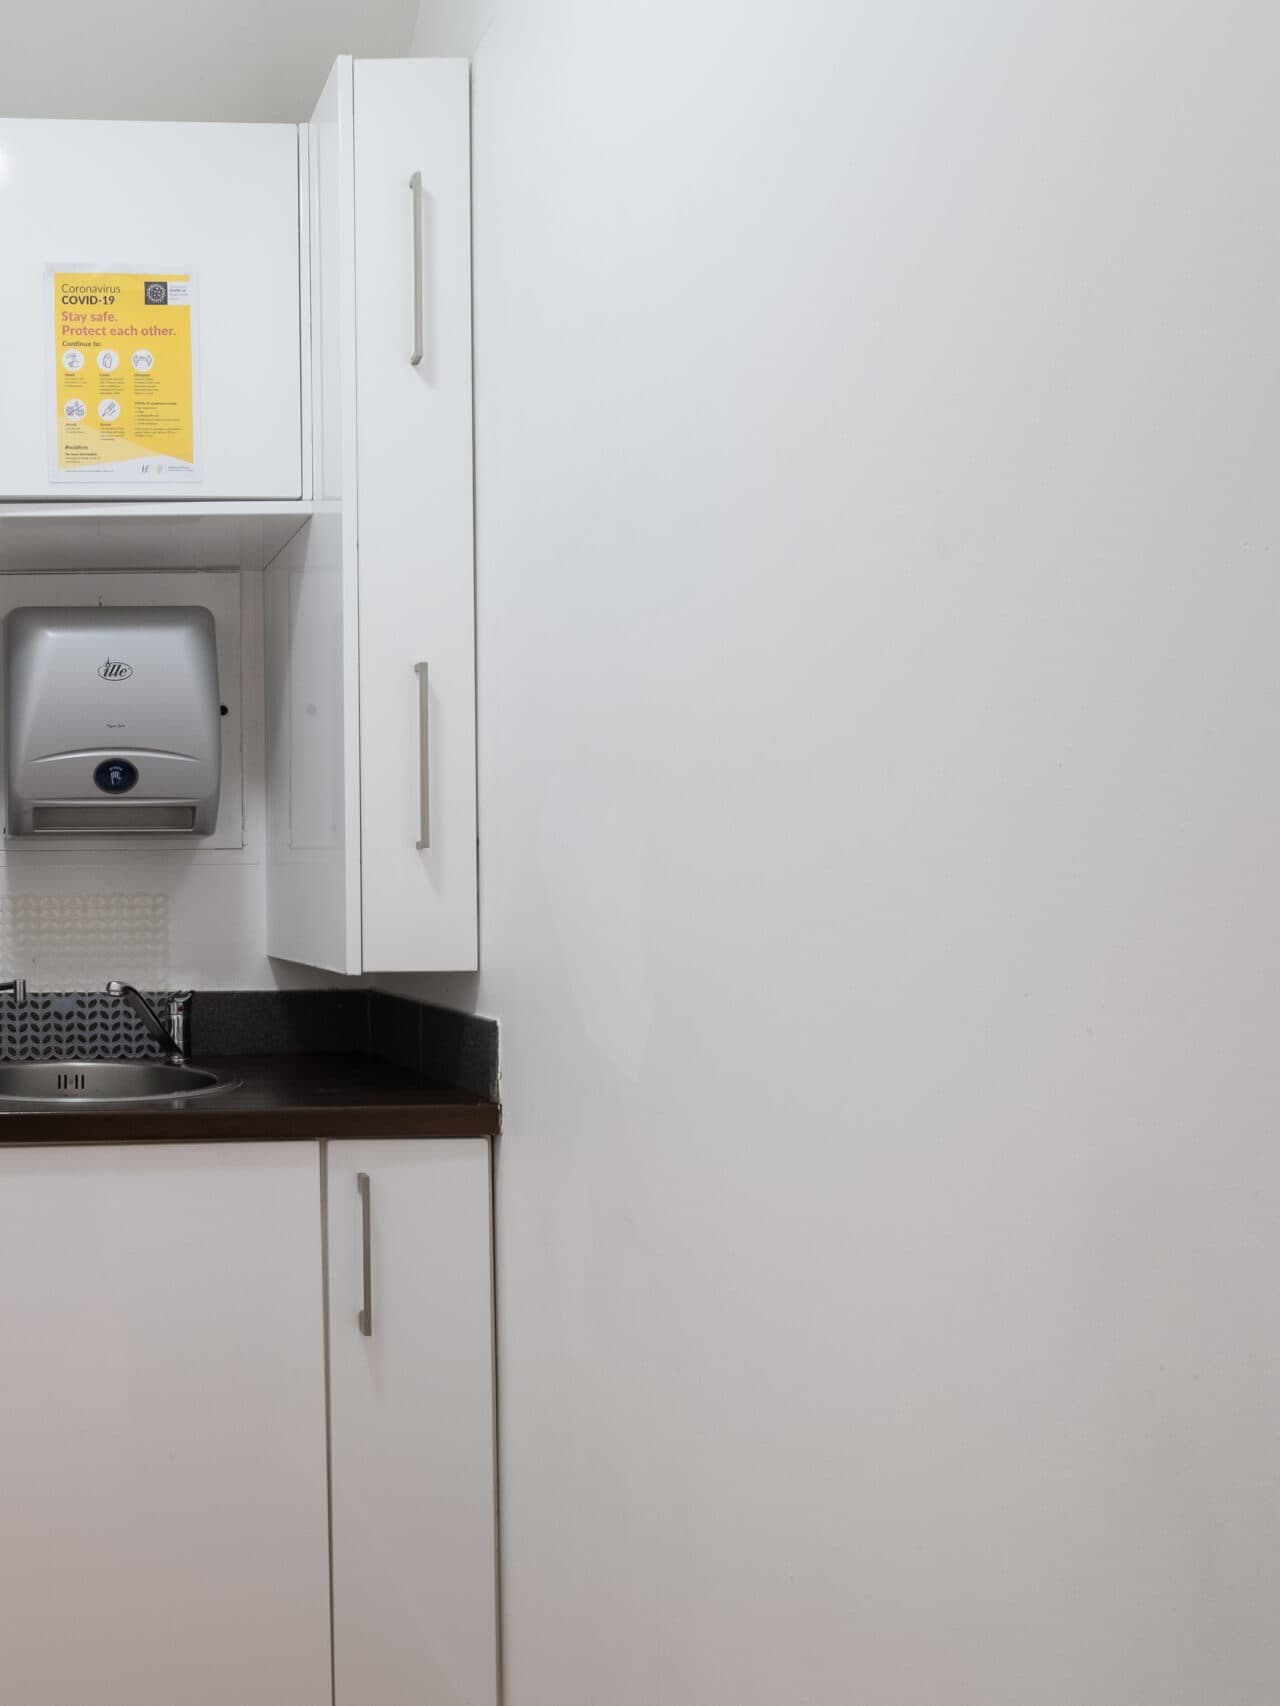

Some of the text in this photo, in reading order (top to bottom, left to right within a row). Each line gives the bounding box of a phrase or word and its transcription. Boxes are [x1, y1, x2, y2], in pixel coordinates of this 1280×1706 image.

[61, 283, 121, 294] Coronavirus
[61, 295, 115, 305] COVID-19
[61, 311, 118, 323] Stay safe.
[62, 325, 177, 336] Protect each other.
